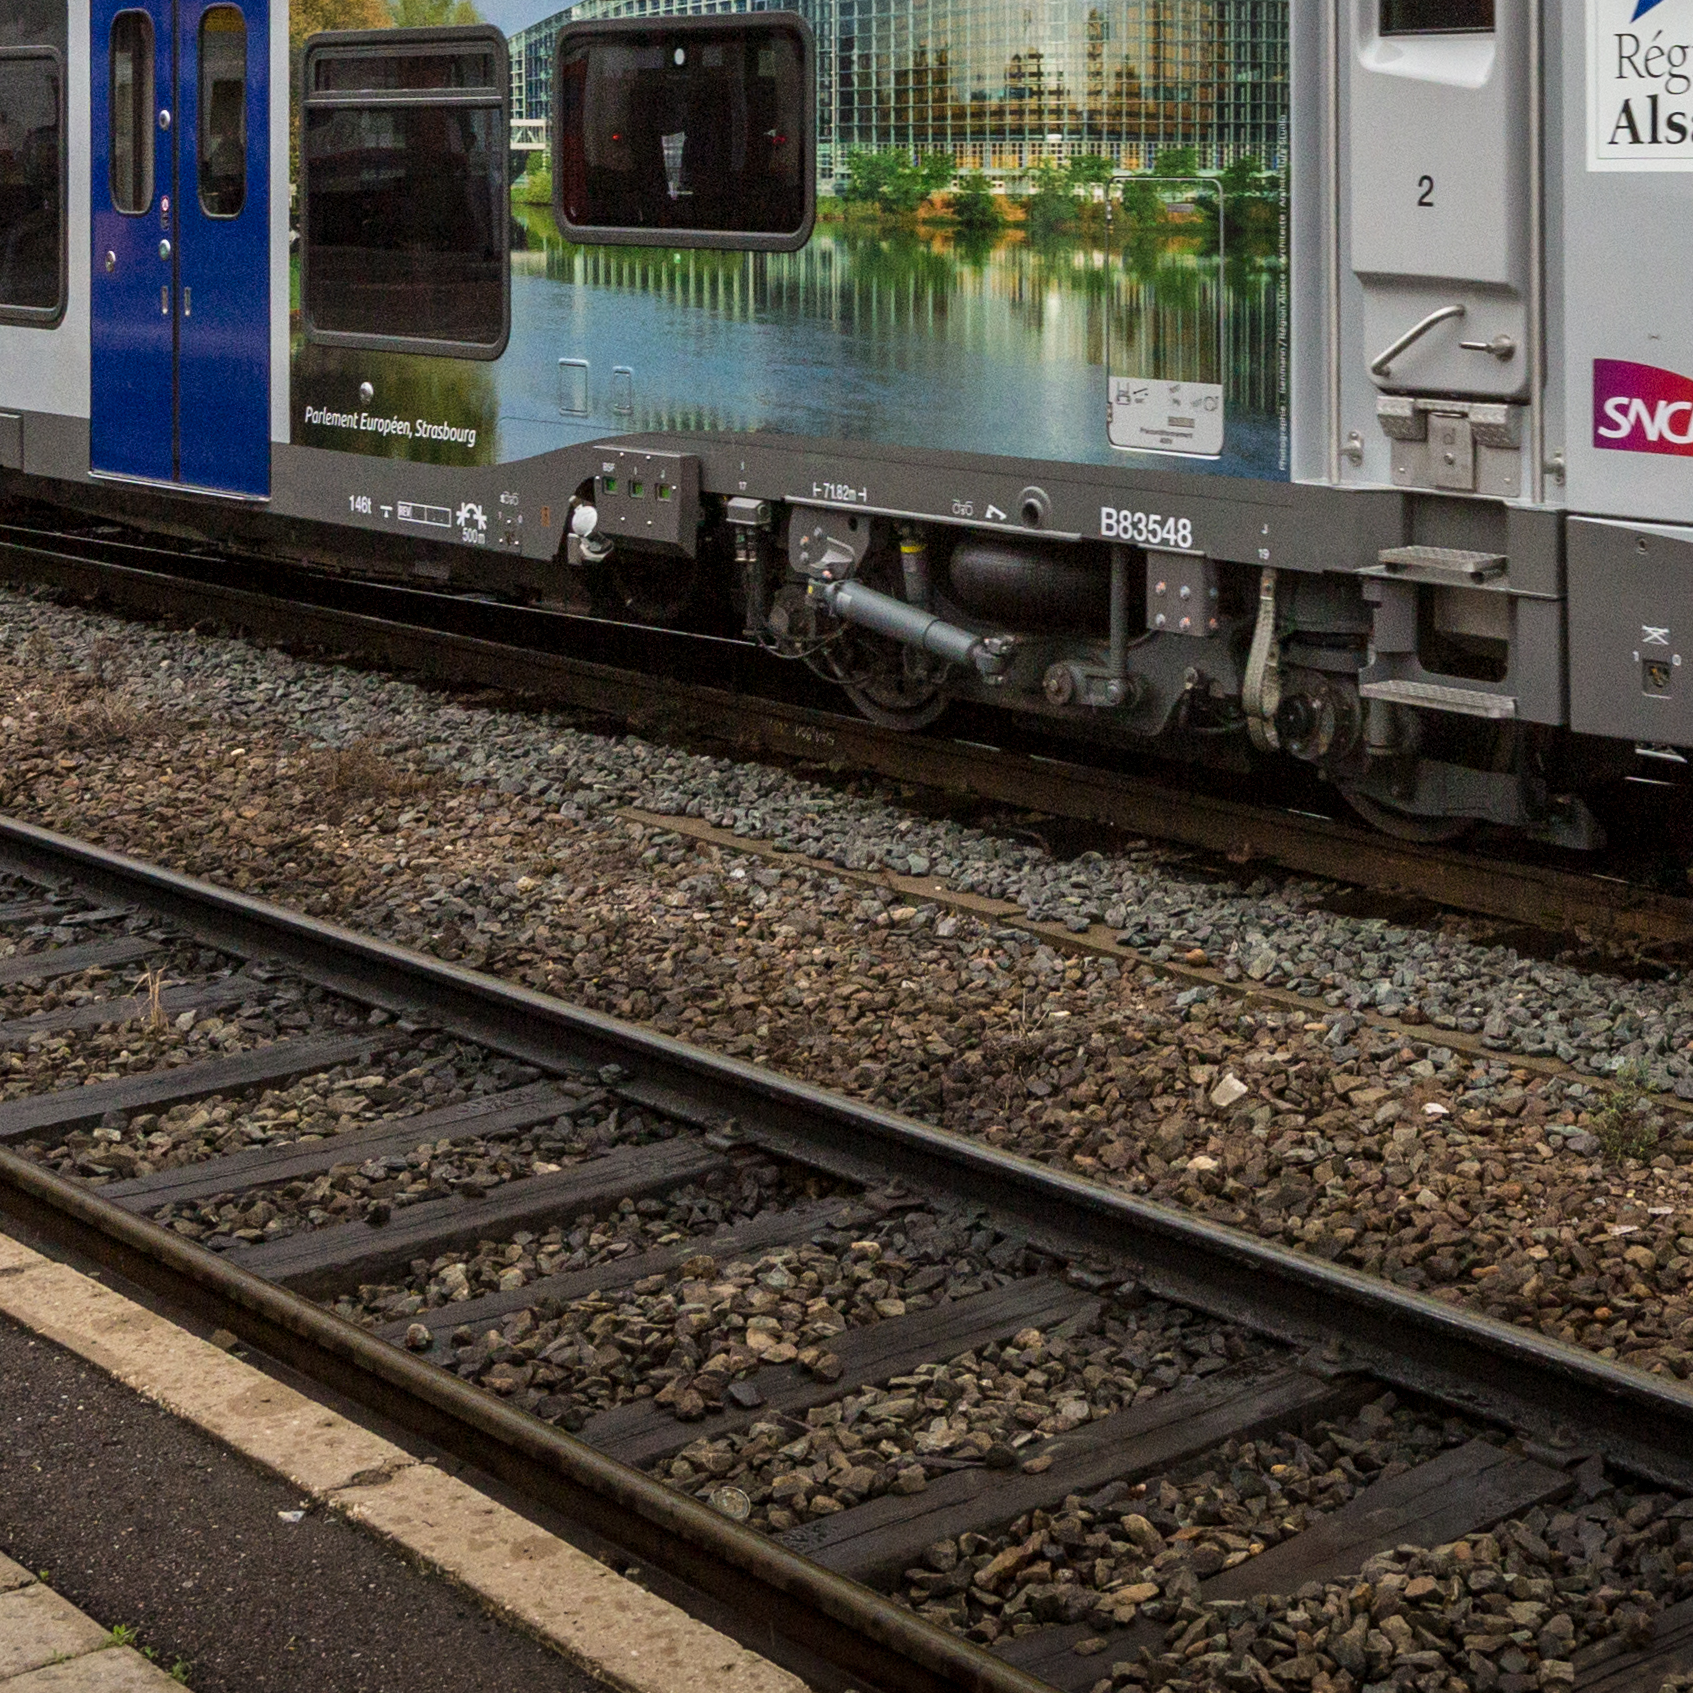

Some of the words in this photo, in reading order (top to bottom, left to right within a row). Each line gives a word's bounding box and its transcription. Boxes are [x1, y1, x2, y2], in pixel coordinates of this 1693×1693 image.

[1417, 174, 1434, 207] 2
[304, 405, 359, 430] Parlement
[360, 412, 413, 439] Européen,
[415, 419, 477, 448] Strasbourg
[348, 494, 373, 515] 146t
[1100, 506, 1193, 548] B83548
